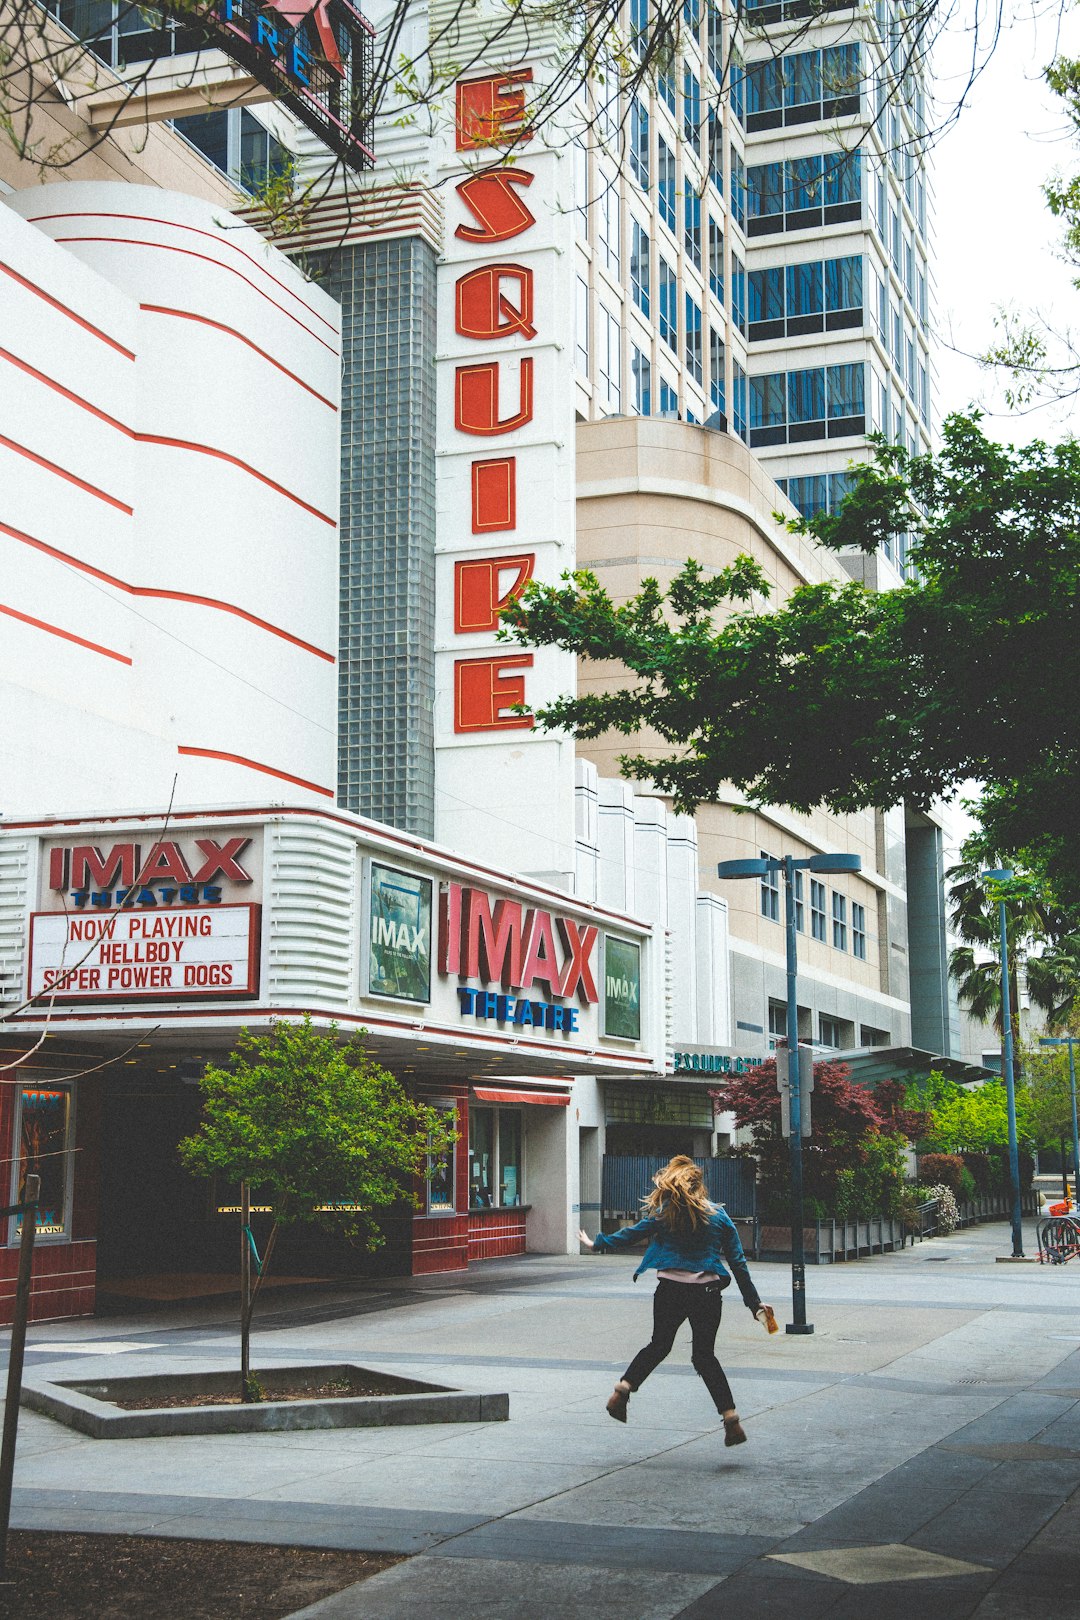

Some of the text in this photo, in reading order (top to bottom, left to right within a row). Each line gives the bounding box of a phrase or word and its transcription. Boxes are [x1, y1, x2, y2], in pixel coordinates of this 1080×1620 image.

[454, 66, 538, 735] ESQUIRE
[50, 837, 252, 891] IMAX
[71, 886, 222, 907] THEATRE
[70, 915, 212, 940] NOW PLAYING
[372, 915, 426, 955] IMAX
[438, 881, 599, 1004] IMAX
[99, 941, 184, 964] HELLBOY
[43, 964, 233, 990] SUPER POWER DOGS
[606, 975, 638, 1004] IMAX
[457, 987, 580, 1033] THEATRE
